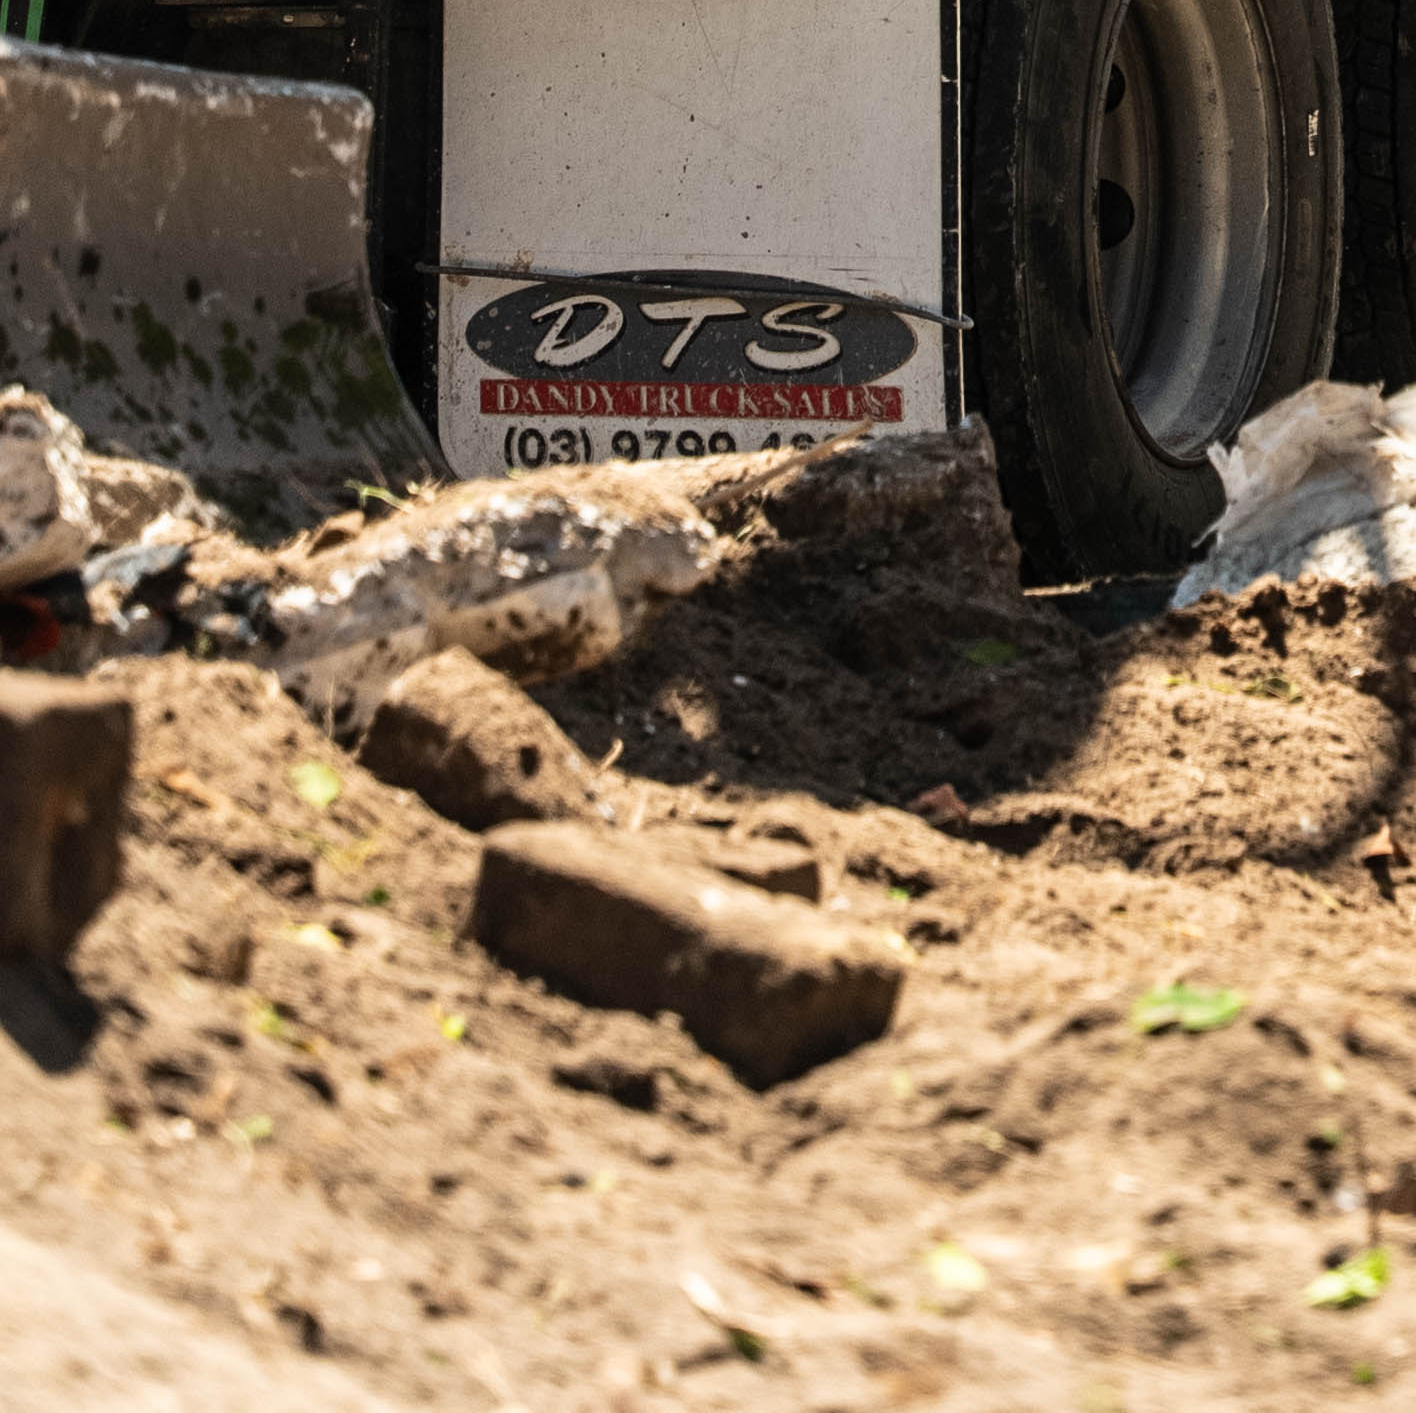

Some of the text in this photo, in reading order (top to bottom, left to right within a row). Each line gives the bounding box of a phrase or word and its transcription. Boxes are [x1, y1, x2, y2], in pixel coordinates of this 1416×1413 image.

[530, 294, 842, 372] DTS
[499, 381, 889, 421] DANDY TRUCK SALES
[503, 426, 595, 469] (03)
